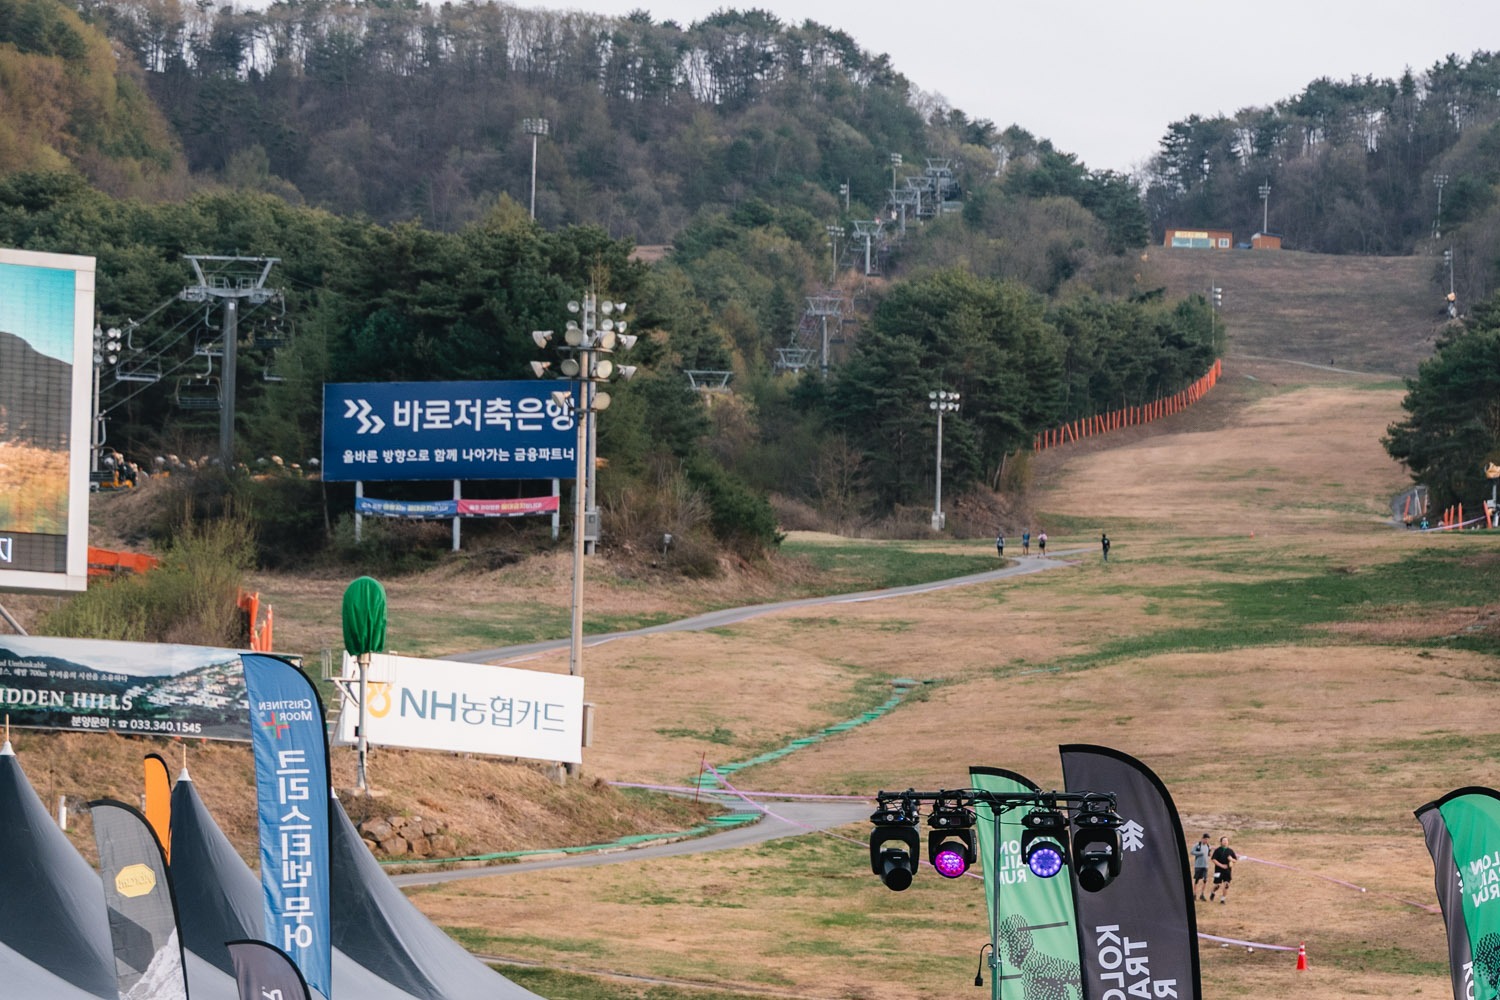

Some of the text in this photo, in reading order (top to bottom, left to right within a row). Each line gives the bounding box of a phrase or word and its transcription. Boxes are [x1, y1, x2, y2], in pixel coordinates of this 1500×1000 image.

[393, 397, 575, 432] 바로저축은행
[342, 447, 575, 463] 올바른 방향으로 함께 나아가는 금융파트너
[0, 687, 133, 711] IDDEN HILLS
[400, 687, 566, 732] NH농협카드
[71, 715, 110, 728] 분양문의
[130, 719, 202, 734] 033.340.1545
